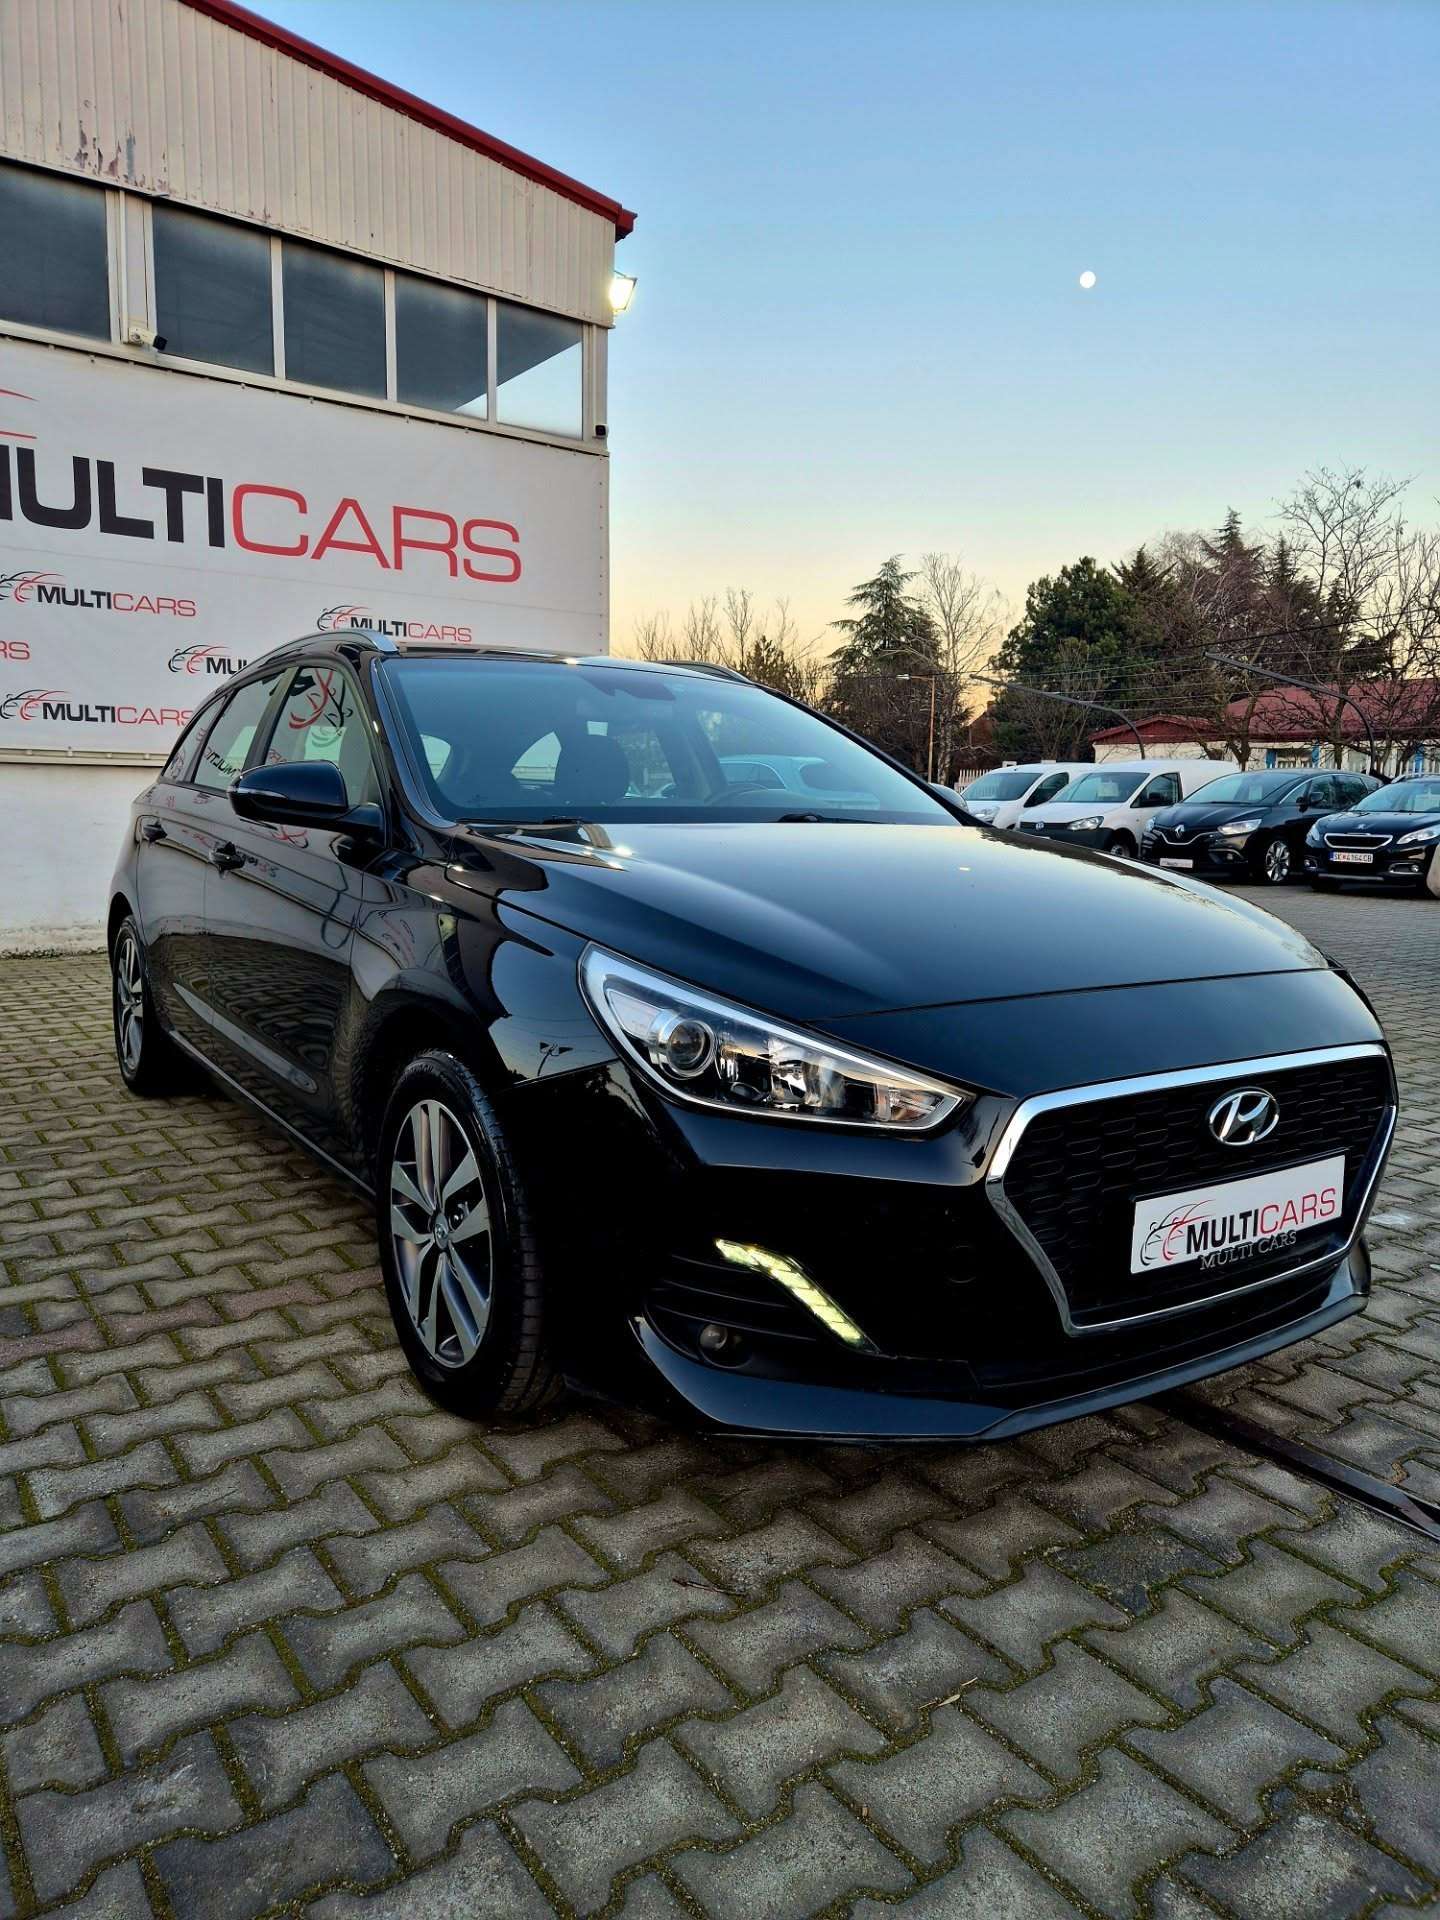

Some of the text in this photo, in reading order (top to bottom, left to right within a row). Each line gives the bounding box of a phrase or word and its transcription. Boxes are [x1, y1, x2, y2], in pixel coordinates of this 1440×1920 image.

[0, 444, 521, 583] ULTICARS
[37, 584, 197, 617] MULTICARS
[1186, 1187, 1336, 1255] MULTICARS
[1199, 1230, 1297, 1270] MULTI CARS
